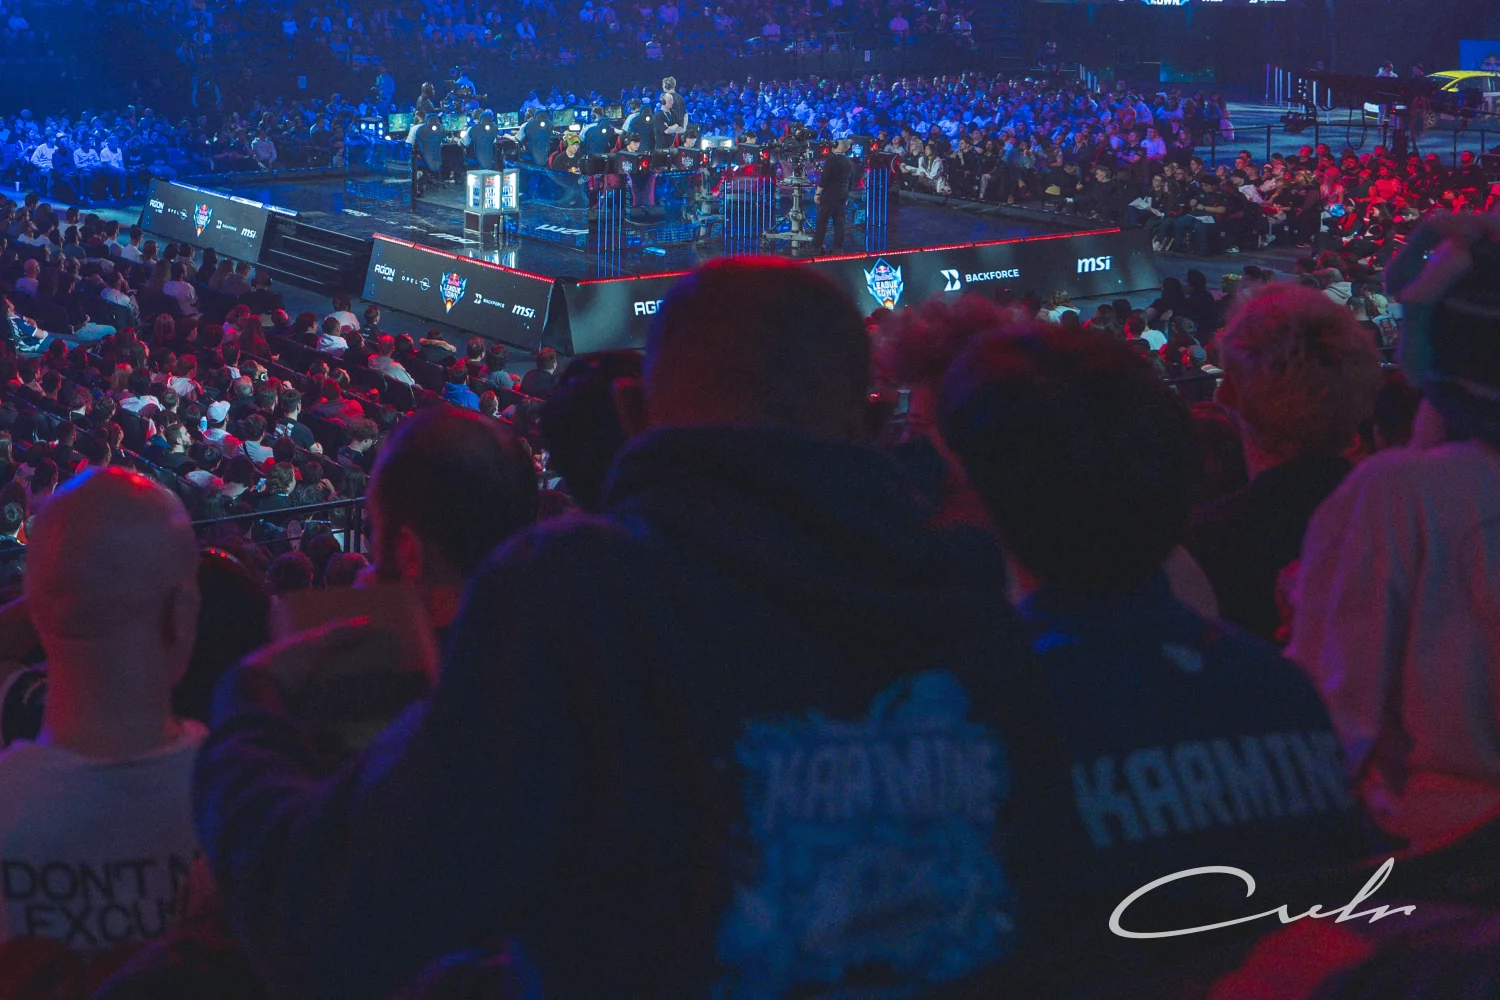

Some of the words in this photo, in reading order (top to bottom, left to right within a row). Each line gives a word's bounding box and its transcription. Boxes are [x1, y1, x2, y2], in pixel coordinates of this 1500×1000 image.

[374, 263, 396, 277] AGON
[1077, 255, 1112, 273] msi
[965, 268, 1020, 282] BACKFORCE
[512, 303, 535, 318] msi
[1071, 729, 1350, 849] KARMIN
[2, 859, 156, 901] DON'T
